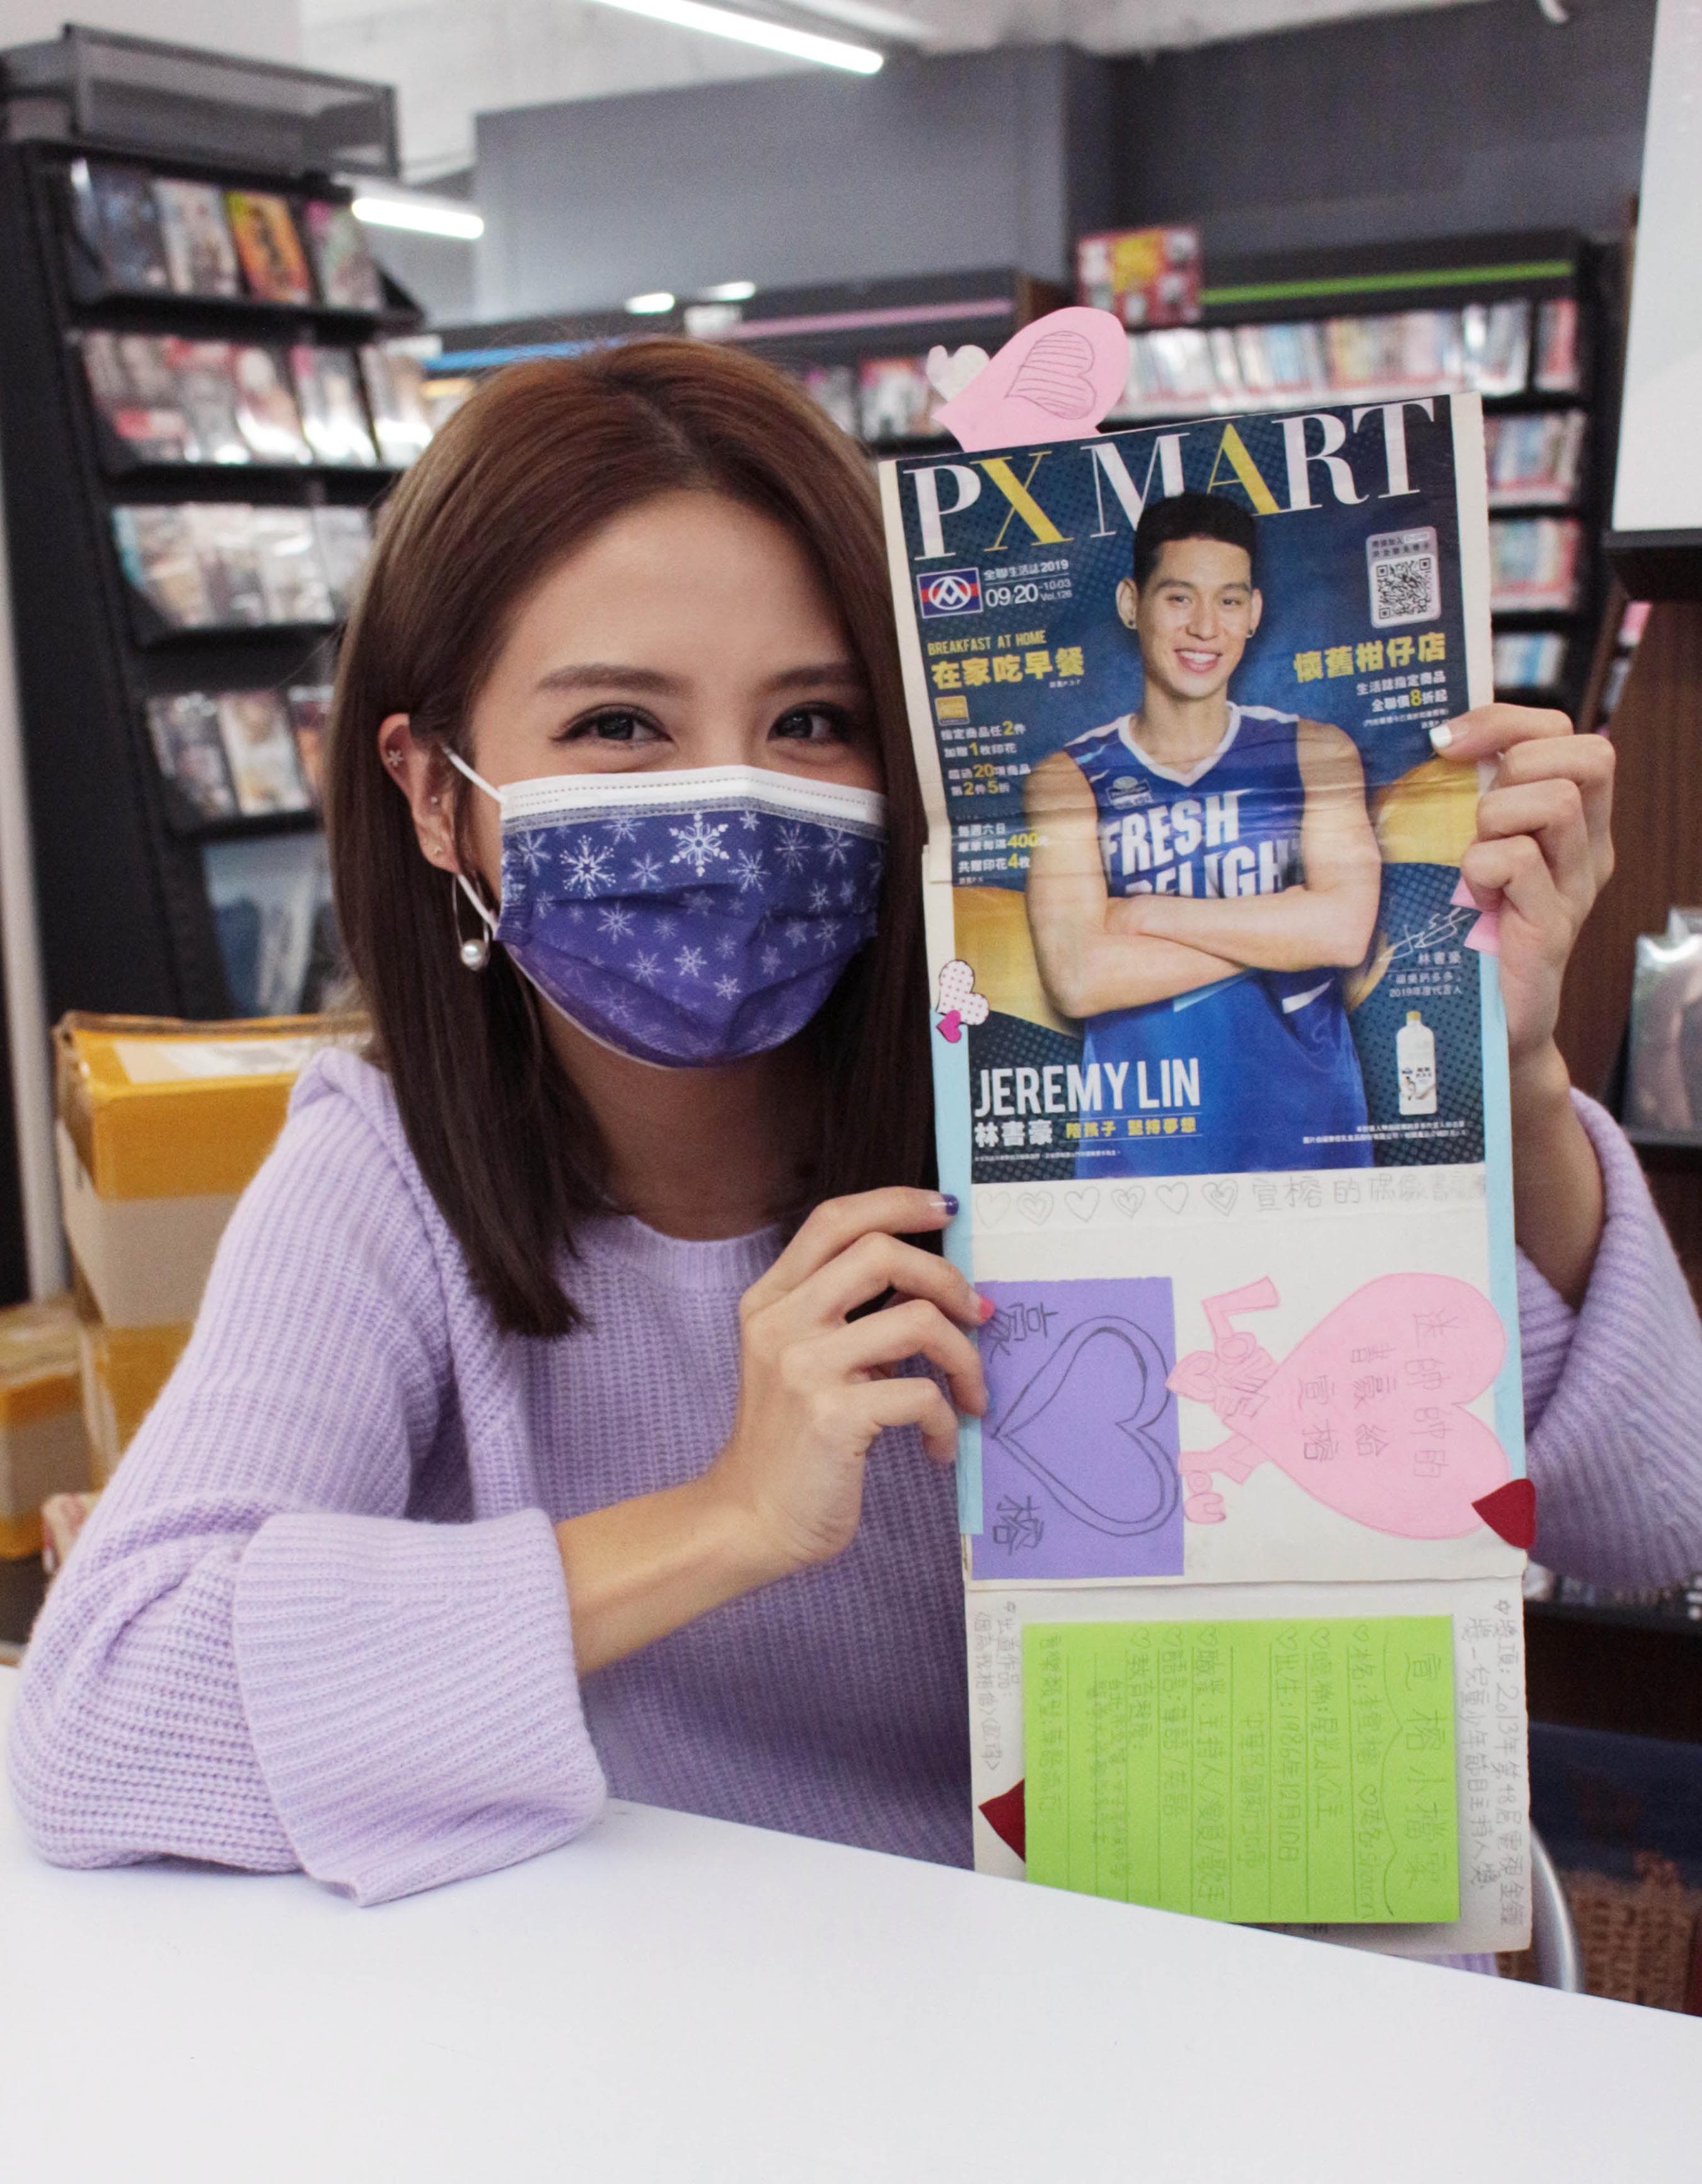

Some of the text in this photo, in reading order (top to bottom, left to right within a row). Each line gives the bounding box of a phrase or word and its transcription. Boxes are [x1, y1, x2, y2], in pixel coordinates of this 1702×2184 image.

[903, 398, 1435, 560] PX MART
[927, 630, 1047, 656] BREAKFAST AT HOME
[930, 645, 1085, 690] 在家吃早餐
[1293, 632, 1447, 683] 懷舊柑仔店
[1098, 794, 1239, 884] FRESH
[975, 1058, 1201, 1118] JEREMY LIN
[975, 1119, 1053, 1148] 林書豪
